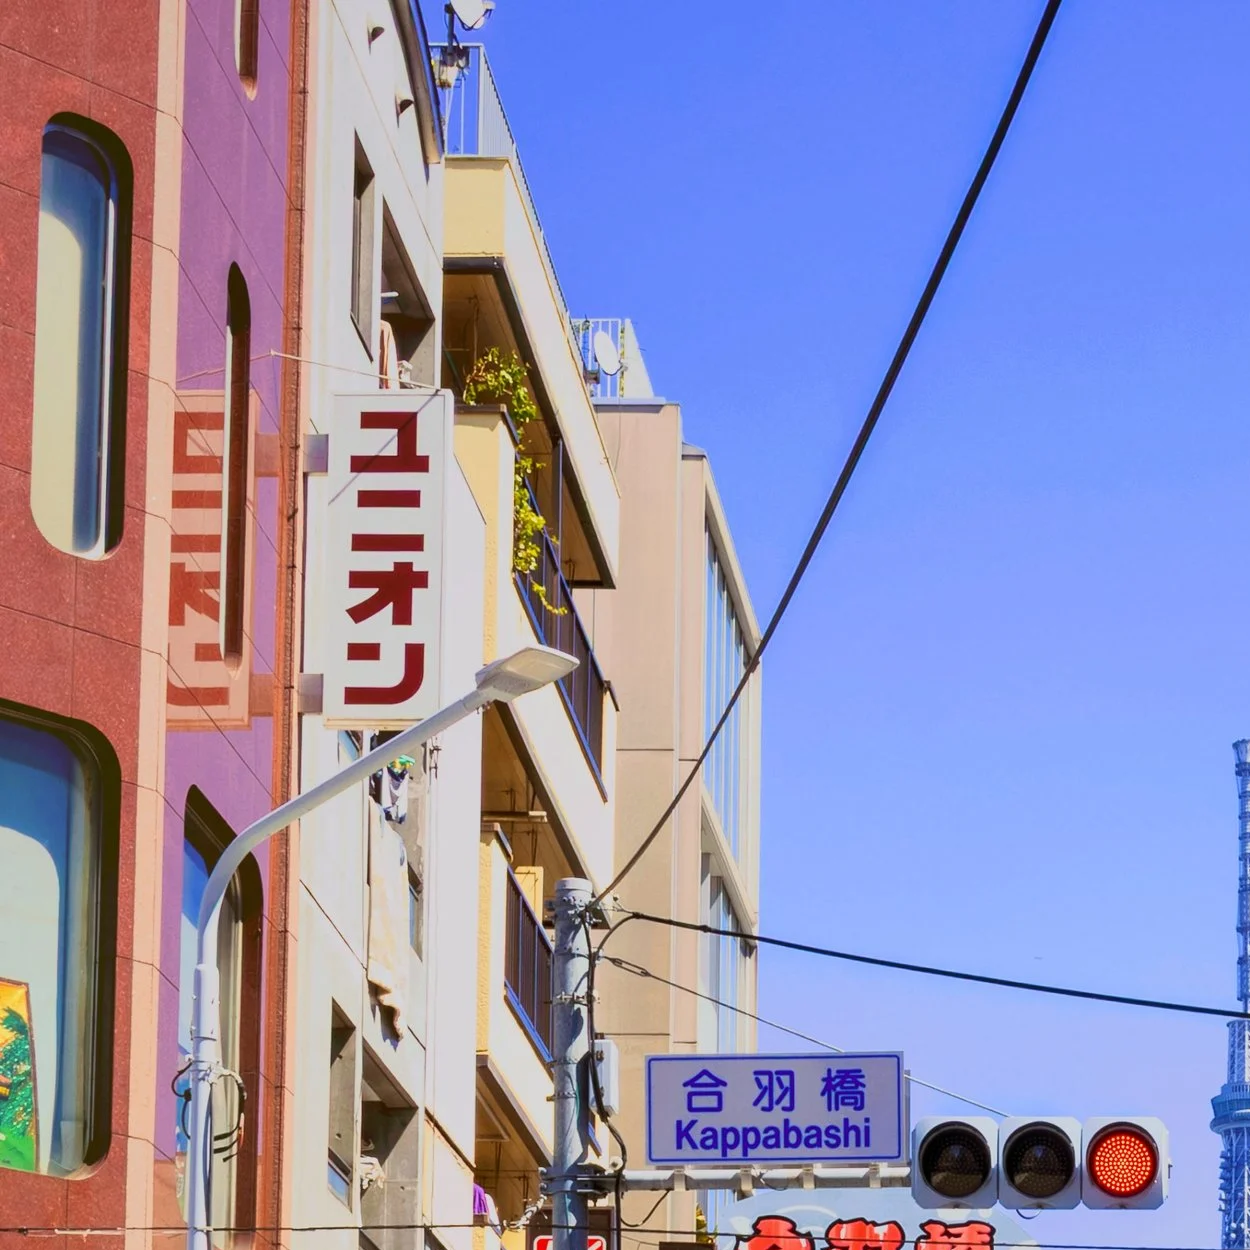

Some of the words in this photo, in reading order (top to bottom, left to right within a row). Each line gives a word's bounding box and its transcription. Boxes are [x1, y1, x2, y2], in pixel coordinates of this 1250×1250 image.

[344, 411, 430, 705] ユニオン
[682, 1068, 867, 1113] 合羽橋
[675, 1117, 872, 1157] Kappabashi
